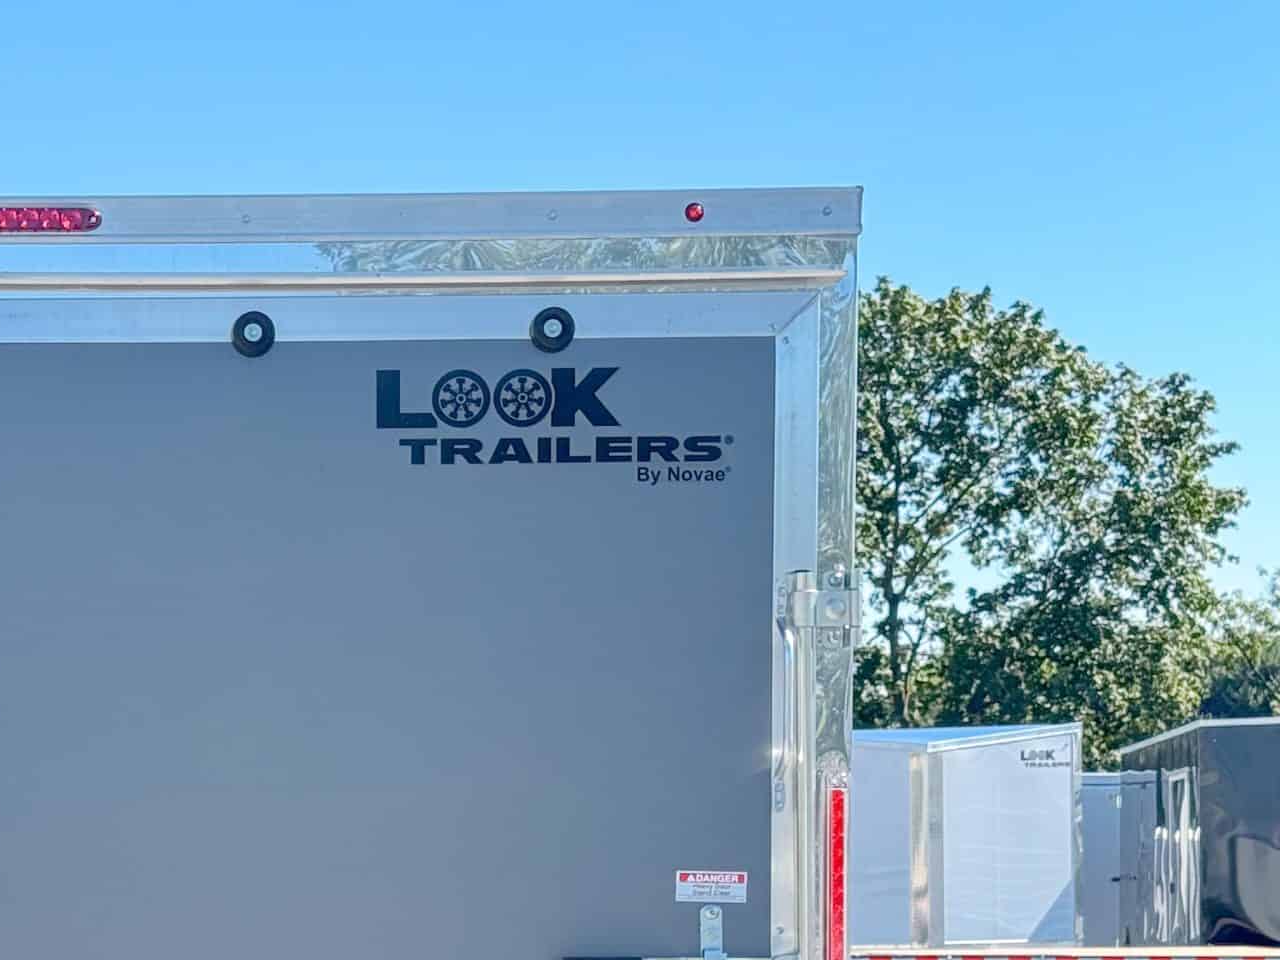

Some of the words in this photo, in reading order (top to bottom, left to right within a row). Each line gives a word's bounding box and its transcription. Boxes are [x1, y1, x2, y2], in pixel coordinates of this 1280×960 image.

[376, 366, 622, 429] LOOK
[399, 435, 724, 465] TRAILERS
[637, 467, 661, 485] By
[667, 467, 725, 482] Novae
[695, 873, 738, 882] DANGER
